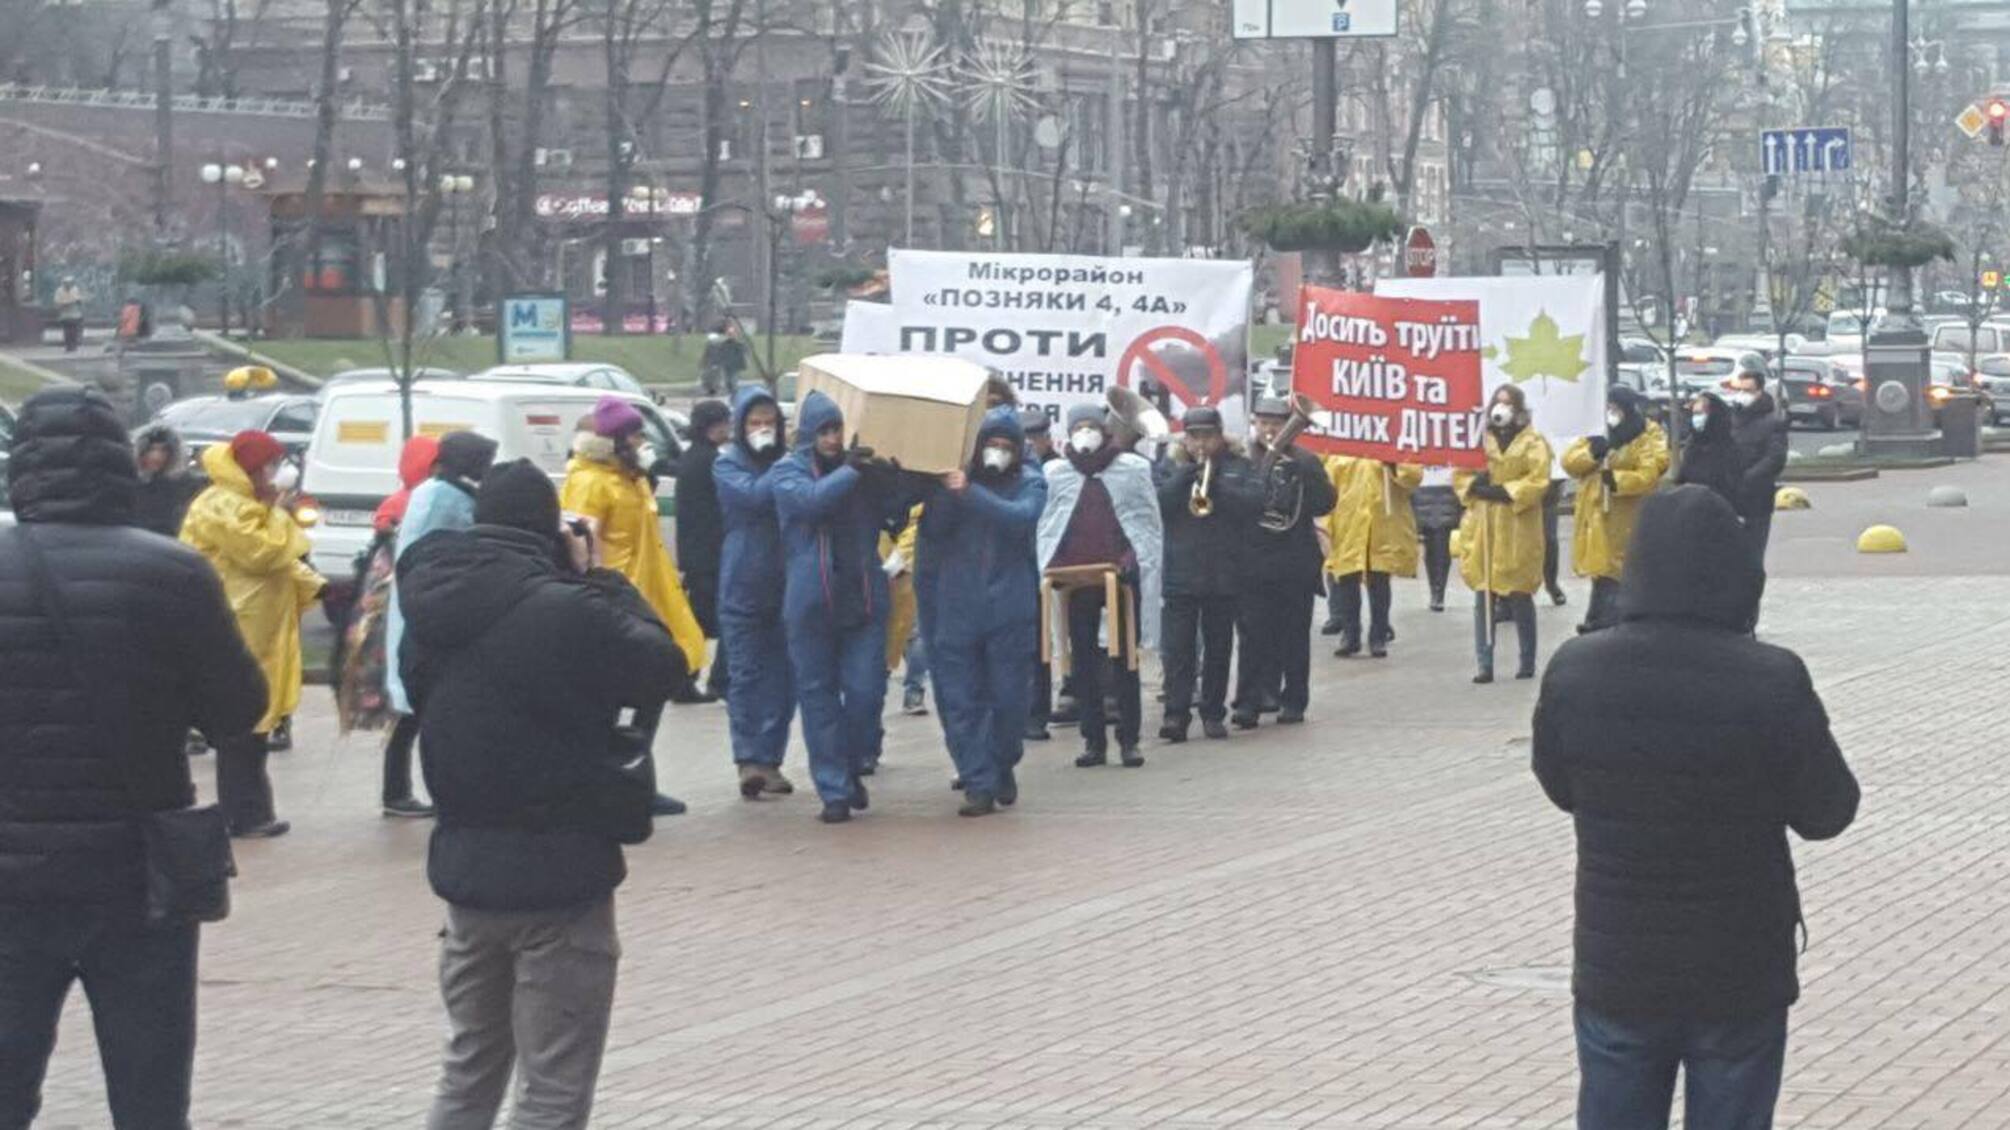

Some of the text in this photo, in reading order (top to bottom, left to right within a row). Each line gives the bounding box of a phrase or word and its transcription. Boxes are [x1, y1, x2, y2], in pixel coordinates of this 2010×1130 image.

[968, 261, 1143, 286] Мікрорайон
[923, 287, 1188, 316] «ПОЗНЯКИ 4, 4А»
[1301, 300, 1387, 347] Досить
[899, 325, 1107, 359] ПРОТИ
[1003, 371, 1105, 394] НЕННЯ
[1332, 354, 1448, 405] КИЇВ та
[1396, 405, 1485, 453] ДІТЕЙ
